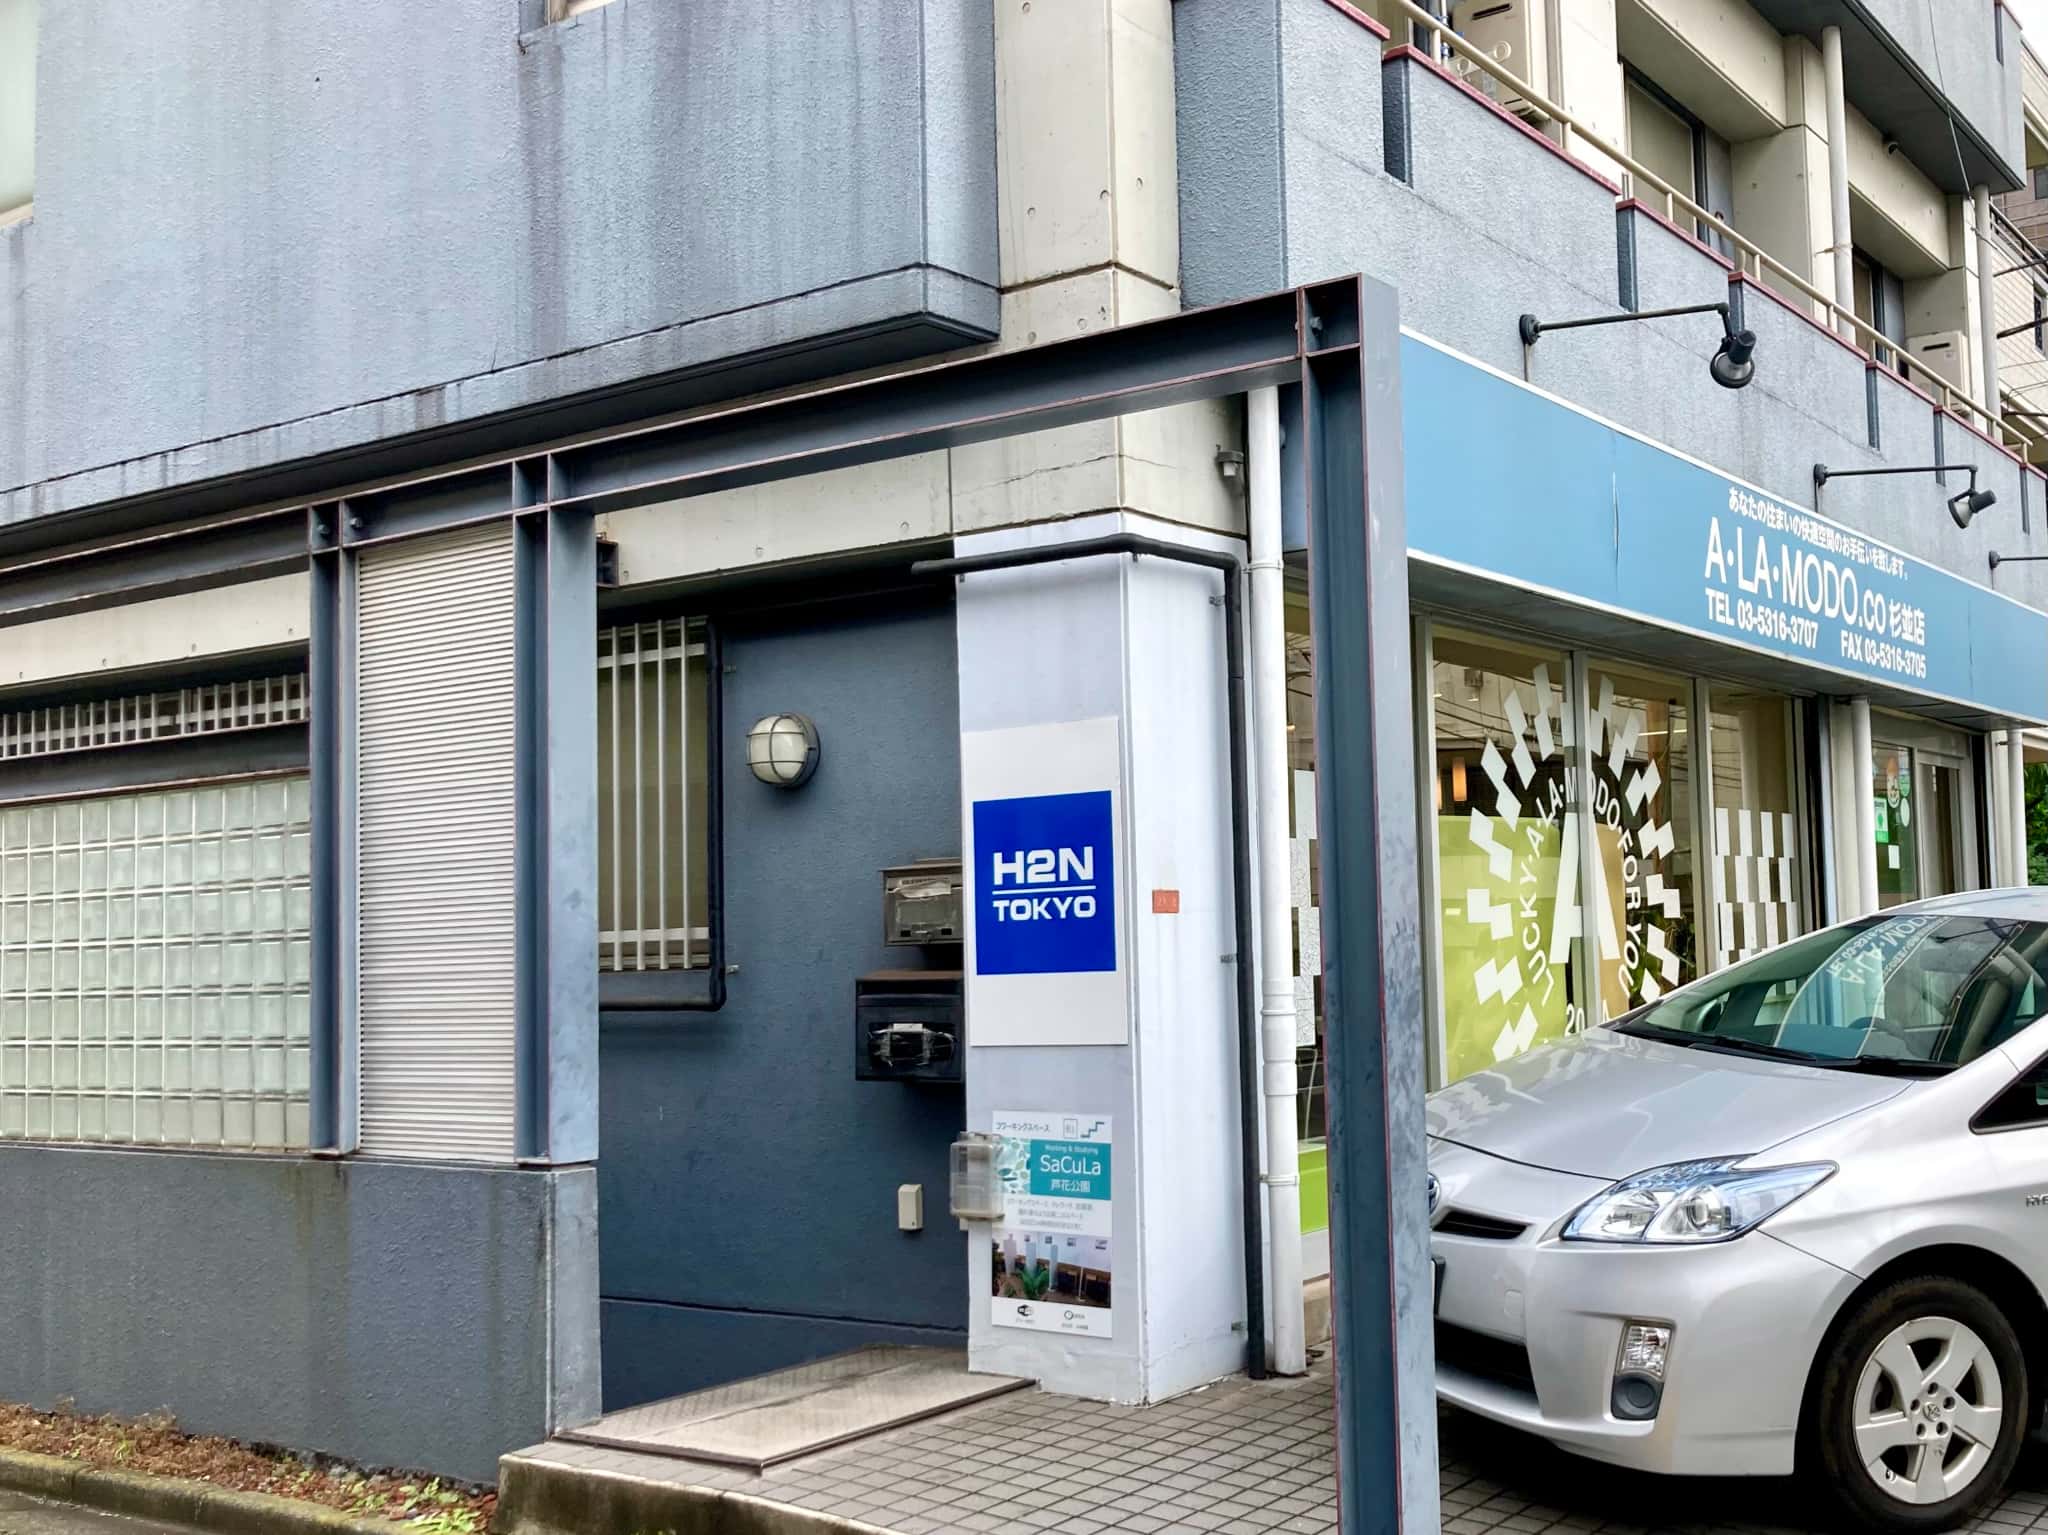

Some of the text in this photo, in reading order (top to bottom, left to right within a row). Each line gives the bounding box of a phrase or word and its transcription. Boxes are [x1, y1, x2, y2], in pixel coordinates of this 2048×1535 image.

[1705, 588, 1818, 649] TEL 03-5316-3707
[1889, 599, 1925, 646] 杉並店
[1841, 630, 1927, 679] FAX 03-5316-3705
[993, 846, 1094, 885] H2N
[993, 895, 1097, 922] TOKYO
[1040, 1154, 1102, 1176] SaCuLa
